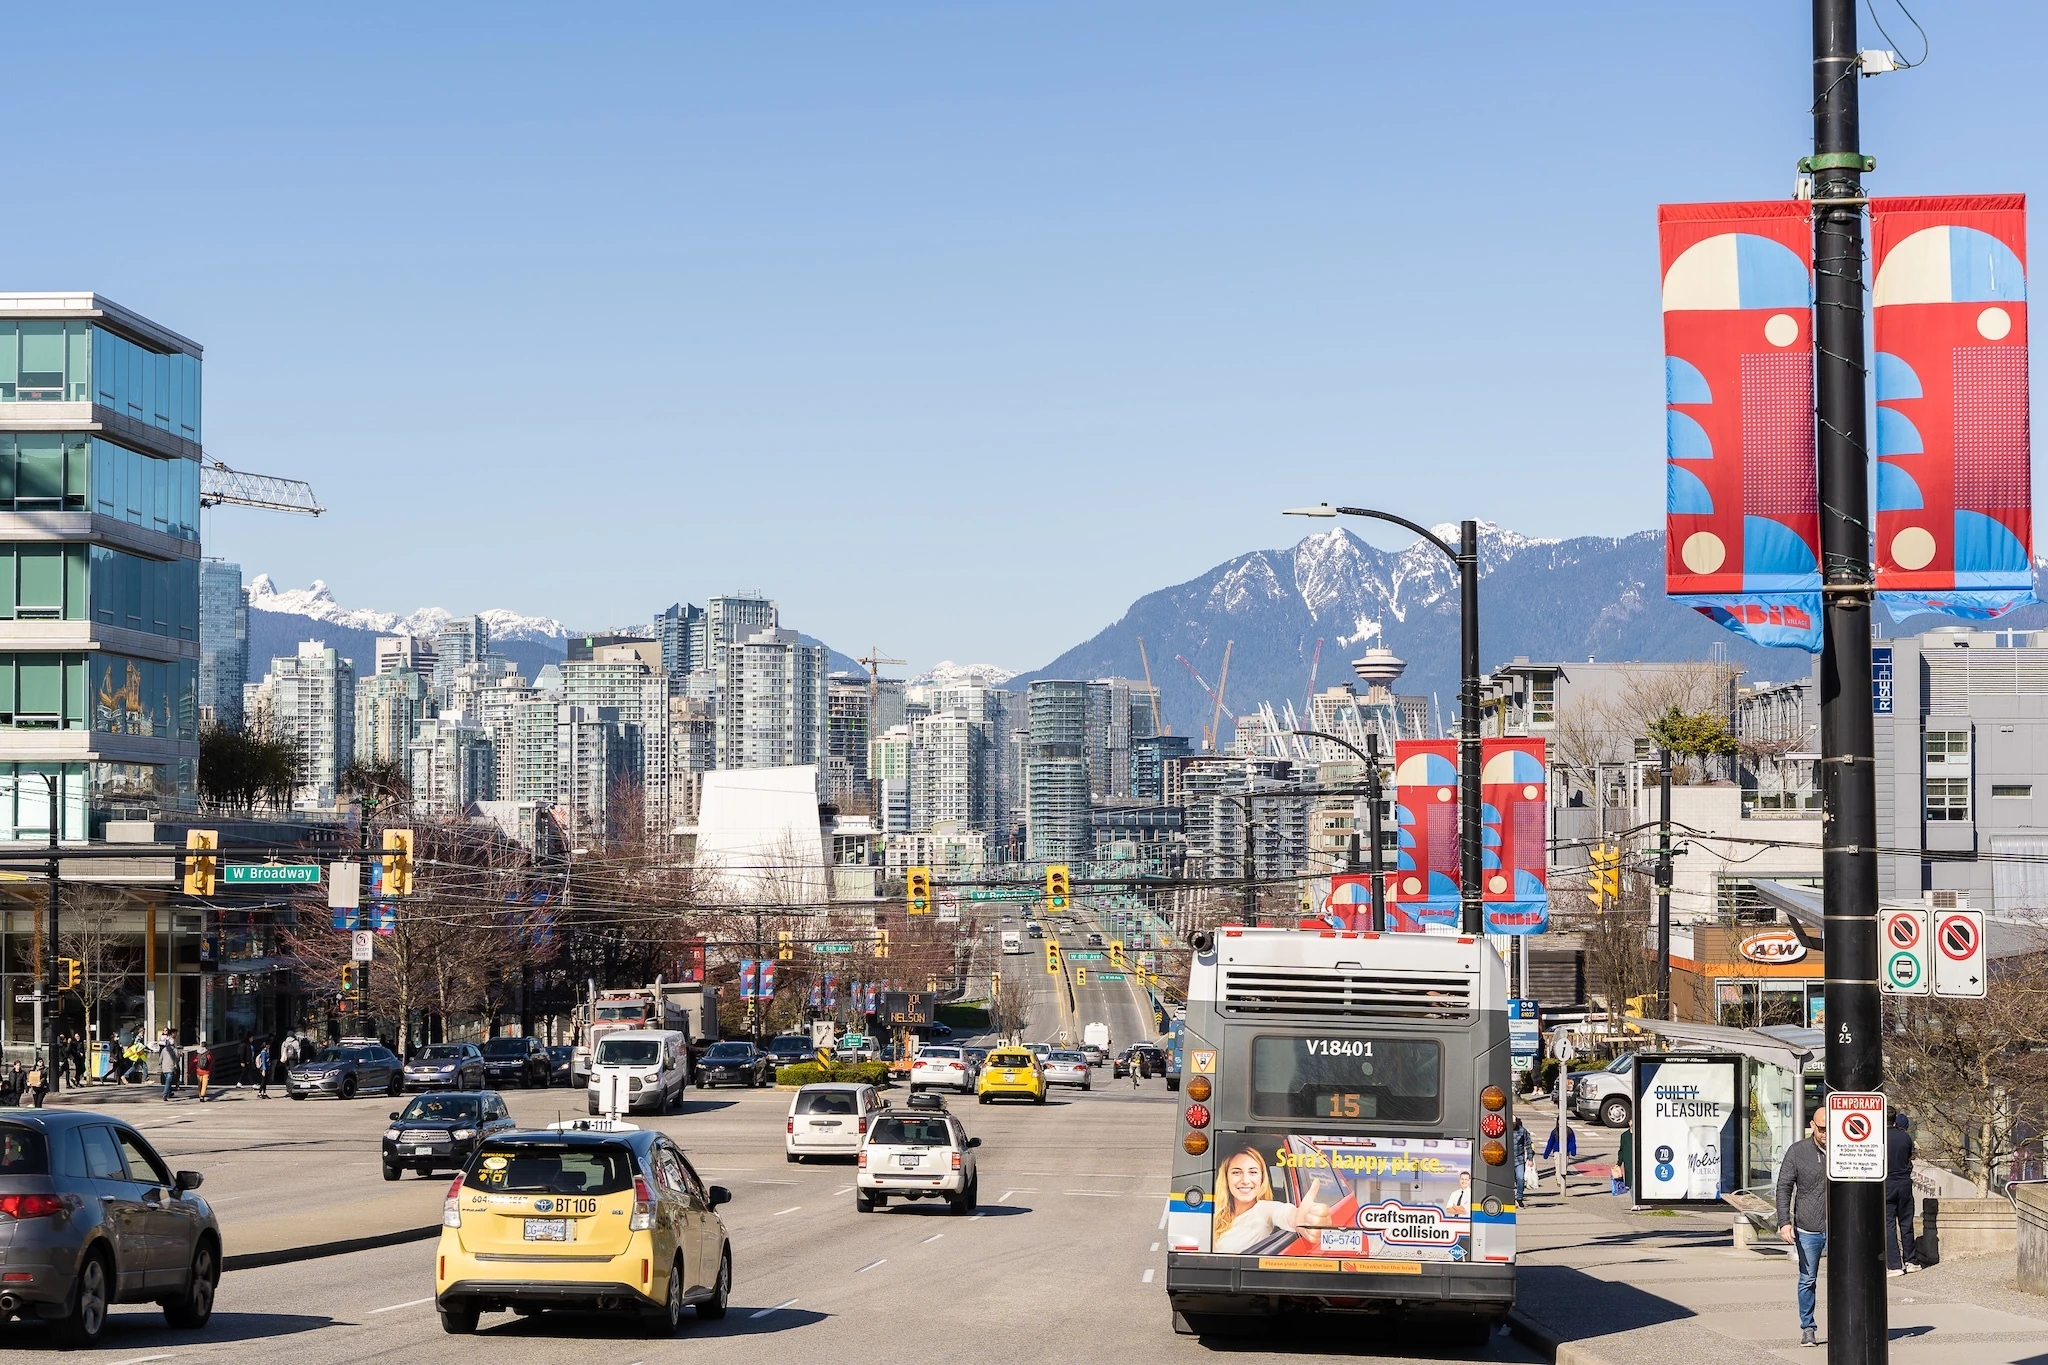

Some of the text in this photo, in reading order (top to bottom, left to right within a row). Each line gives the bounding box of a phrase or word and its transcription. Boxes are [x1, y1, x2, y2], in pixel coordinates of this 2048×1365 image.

[1787, 617, 1809, 628] VILLAGE
[1879, 681, 1890, 711] RISE
[233, 867, 312, 882] W Broadway
[1751, 943, 1800, 956] A&W
[891, 1012, 925, 1022] NELSON
[1841, 1022, 1848, 1033] 6
[1838, 1033, 1852, 1044] 25
[1306, 1039, 1373, 1057] V18401
[1656, 1085, 1698, 1100] GUILTY
[1329, 1093, 1361, 1117] 15
[1656, 1102, 1720, 1117] PLEASURE
[1832, 1097, 1881, 1110] TEMPORARY
[1660, 1149, 1669, 1158] 70
[1276, 1148, 1328, 1170] Sara's
[1333, 1150, 1387, 1177] happy
[1391, 1152, 1445, 1178] place.
[1696, 1168, 1717, 1176] ULTRA
[1365, 1210, 1435, 1225] craftsman
[1392, 1227, 1449, 1240] collision
